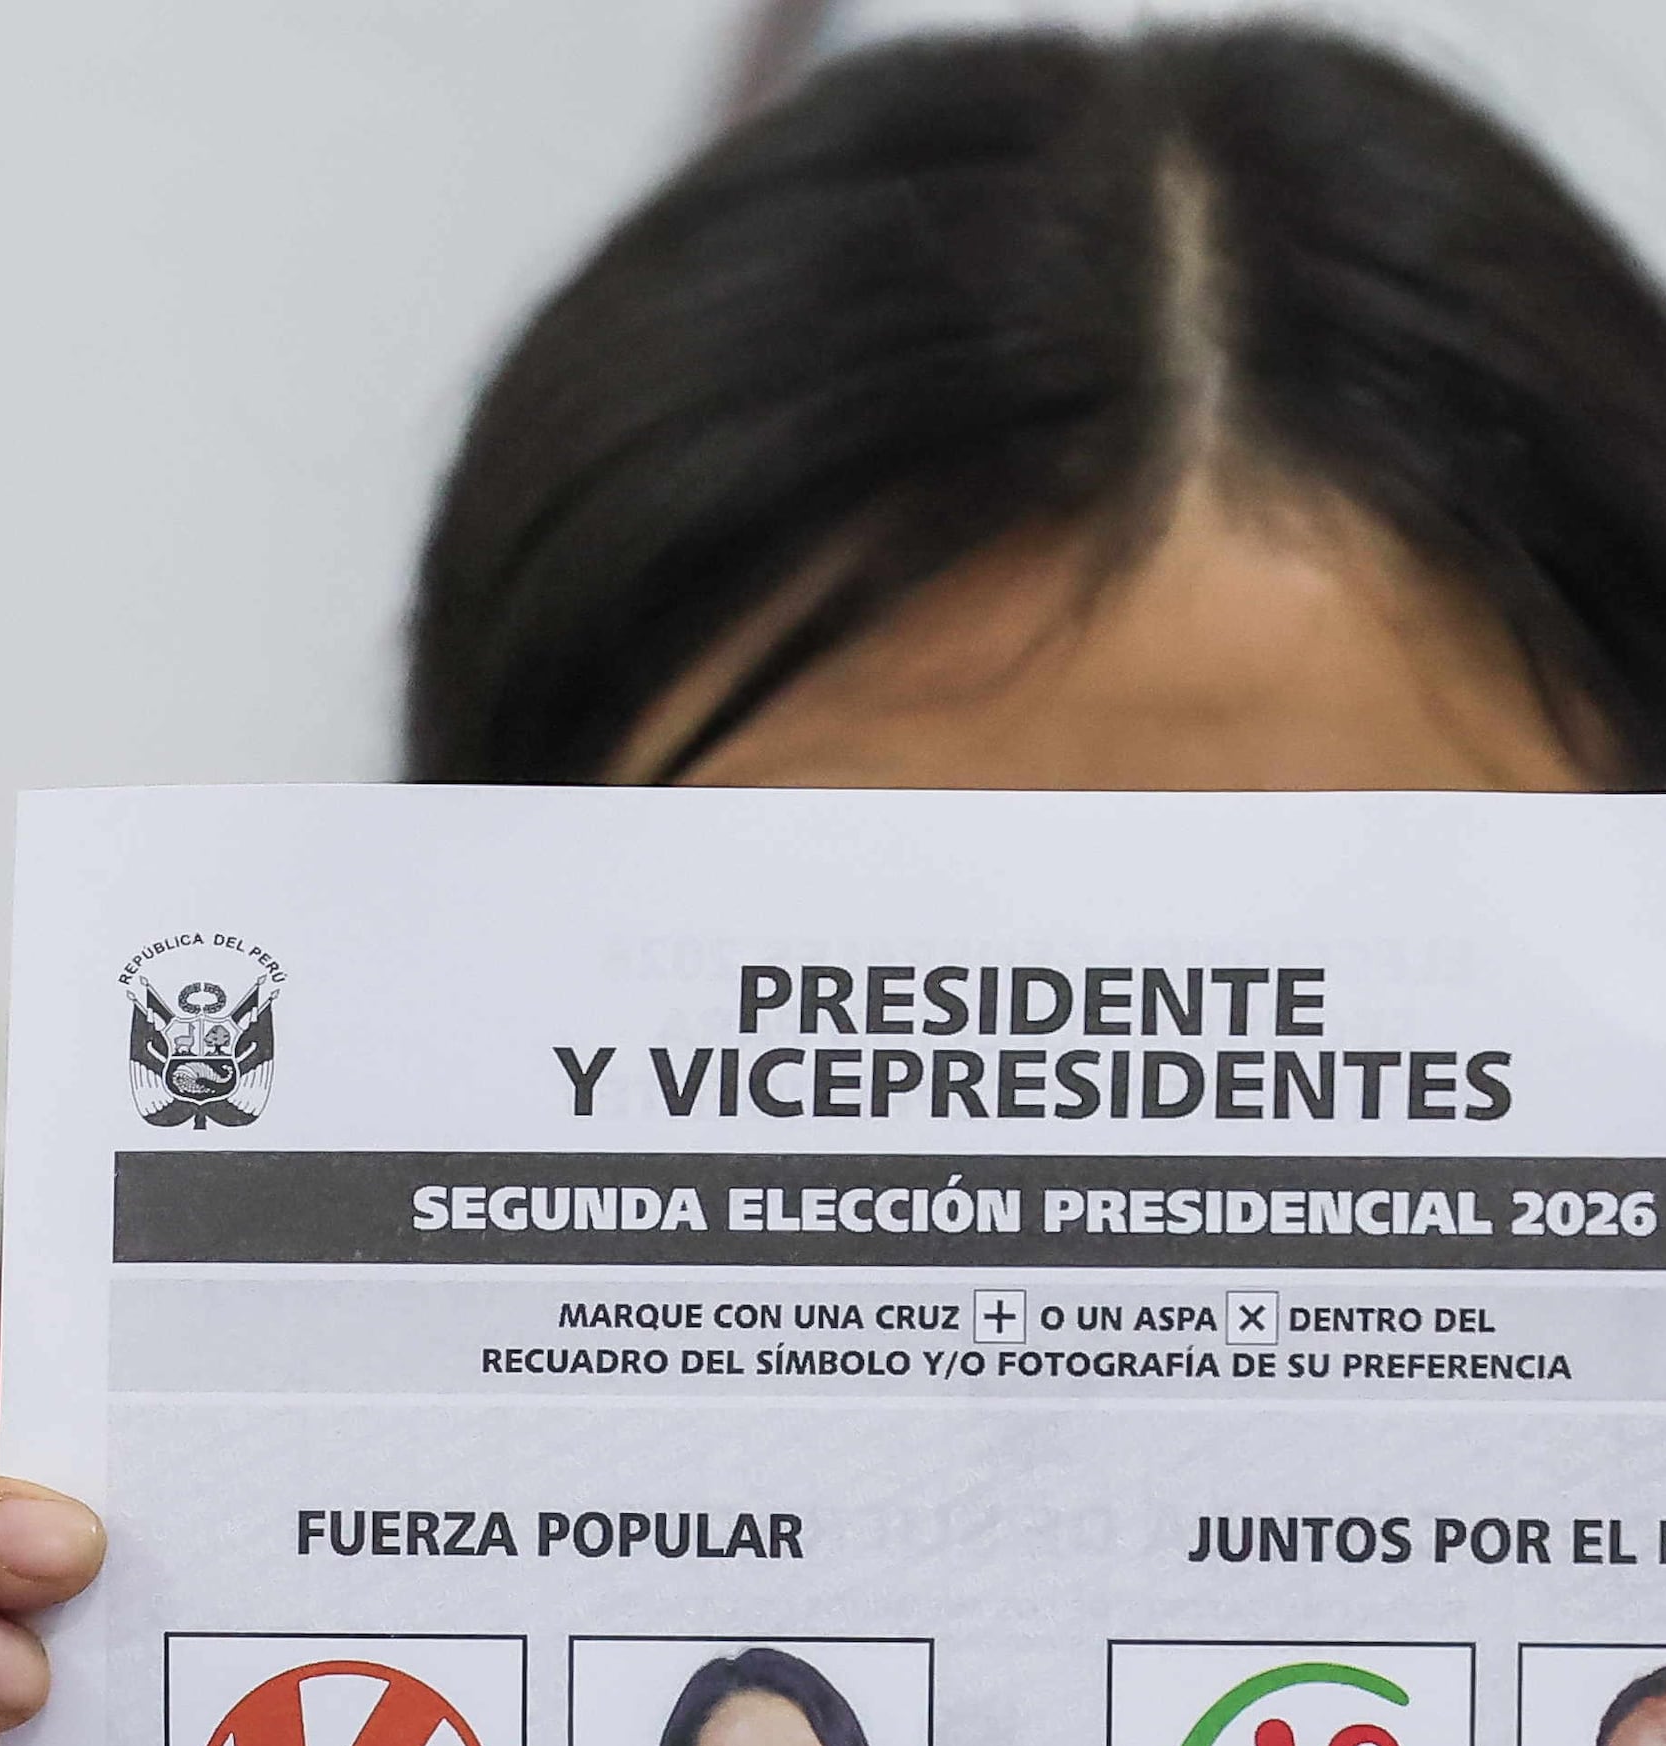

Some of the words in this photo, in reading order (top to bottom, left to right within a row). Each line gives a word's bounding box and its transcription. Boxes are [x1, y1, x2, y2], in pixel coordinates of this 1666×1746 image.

[118, 932, 204, 985] REPÚBLICA
[213, 933, 245, 952] DEL
[248, 946, 288, 983] PERÚ
[739, 965, 1325, 1037] PRESIDENTE
[552, 1046, 617, 1117] Y
[649, 1047, 1512, 1121] VICEPRESIDENTES
[412, 1185, 708, 1231] SEGUNDA
[728, 1175, 1021, 1234] ELECCIÓN
[1044, 1189, 1493, 1235] PRESIDENCIAL
[1511, 1191, 1657, 1237] 2026
[558, 1303, 703, 1331] MARQUE
[713, 1303, 782, 1329] CON
[794, 1304, 865, 1330] UNA
[875, 1304, 960, 1331] CRUZ
[1040, 1305, 1065, 1331] O
[1077, 1305, 1123, 1331] UN
[1132, 1306, 1218, 1332] ASPA
[1289, 1306, 1423, 1333] DENTRO
[1434, 1307, 1496, 1333] DEL
[482, 1348, 669, 1374] RECUADRO
[681, 1349, 745, 1375] DEL
[756, 1342, 911, 1376] SÍMBOLO
[923, 1350, 986, 1380] Y/O
[997, 1343, 1220, 1378] FOTOGRAFÍA
[1232, 1352, 1278, 1378] DE
[1287, 1352, 1330, 1379] SU
[1343, 1353, 1573, 1380] PREFERENCIA
[297, 1510, 519, 1557] FUERZA
[537, 1511, 804, 1559] POPULAR
[1188, 1516, 1412, 1564] JUNTOS
[1434, 1517, 1552, 1565] POR
[1572, 1518, 1638, 1565] EL
